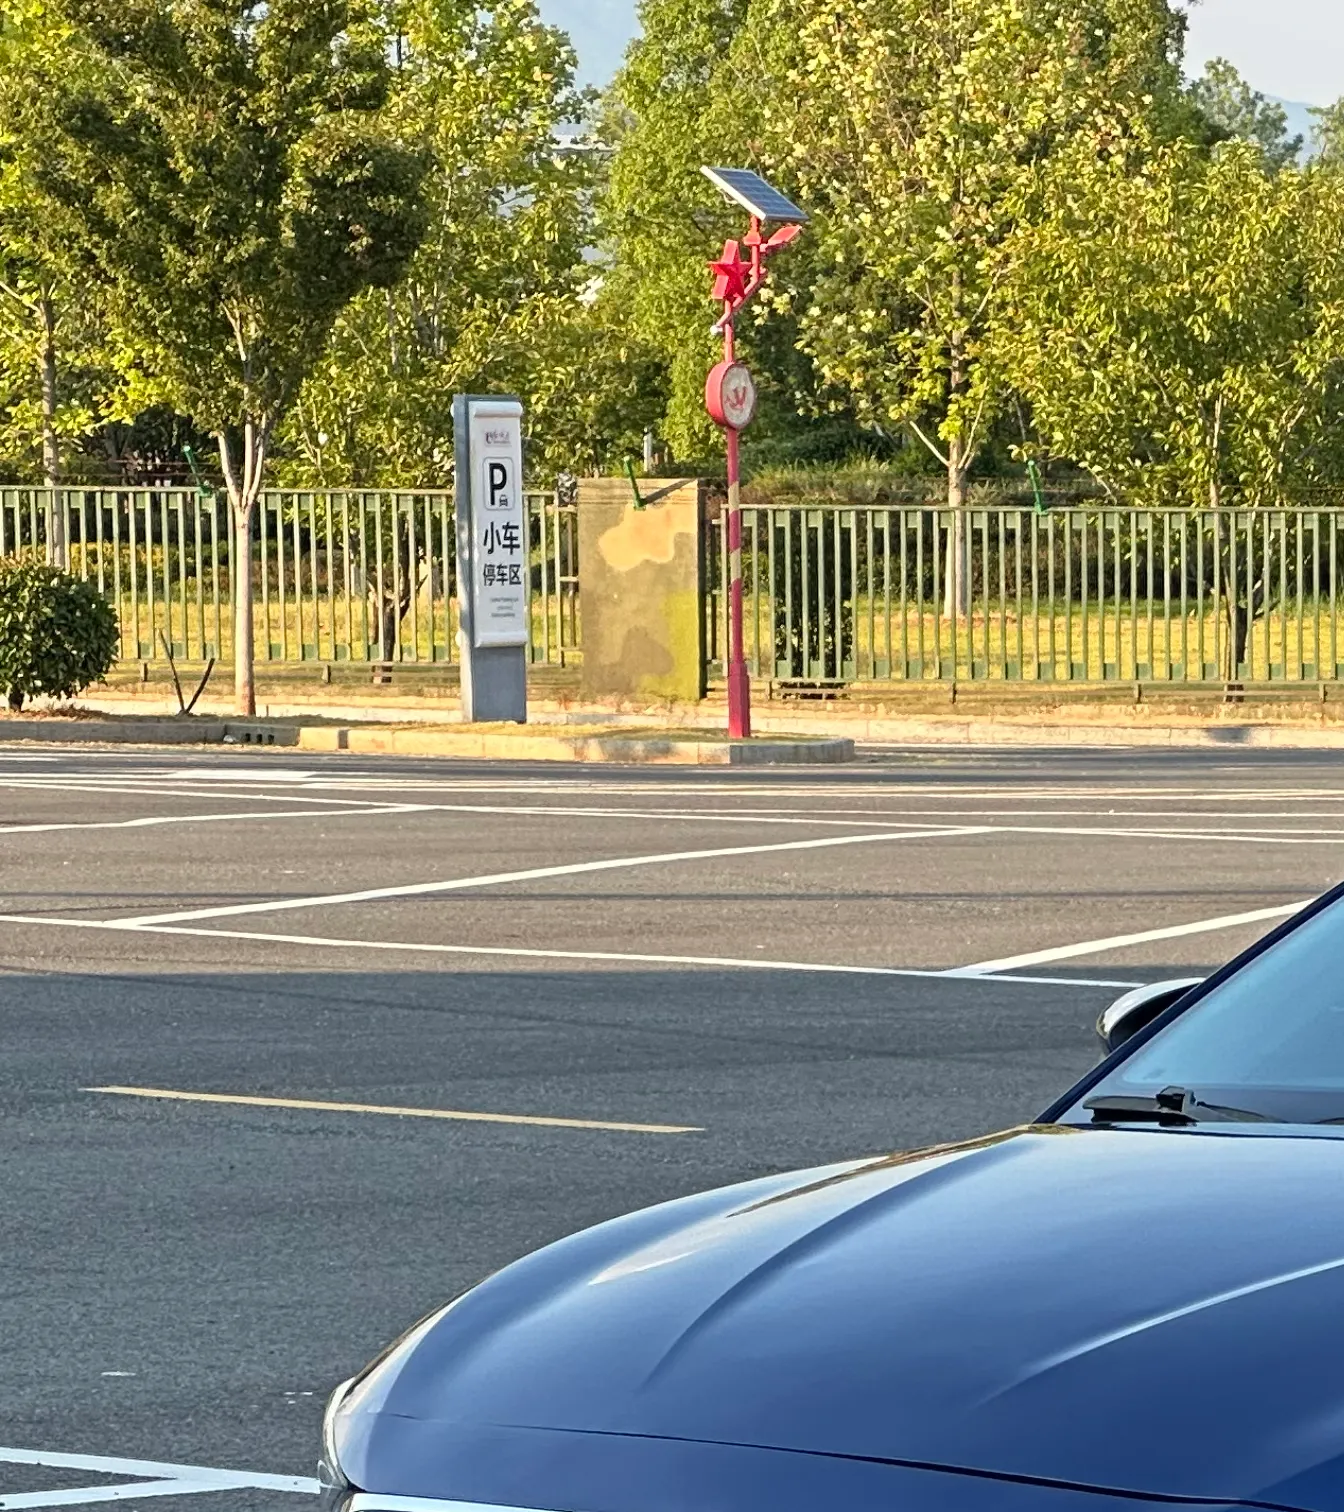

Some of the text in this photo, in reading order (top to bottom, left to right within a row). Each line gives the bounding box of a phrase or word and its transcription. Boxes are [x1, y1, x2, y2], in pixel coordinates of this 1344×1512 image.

[489, 463, 507, 506] P
[483, 521, 521, 556] 小车
[482, 563, 522, 587] 停车区
